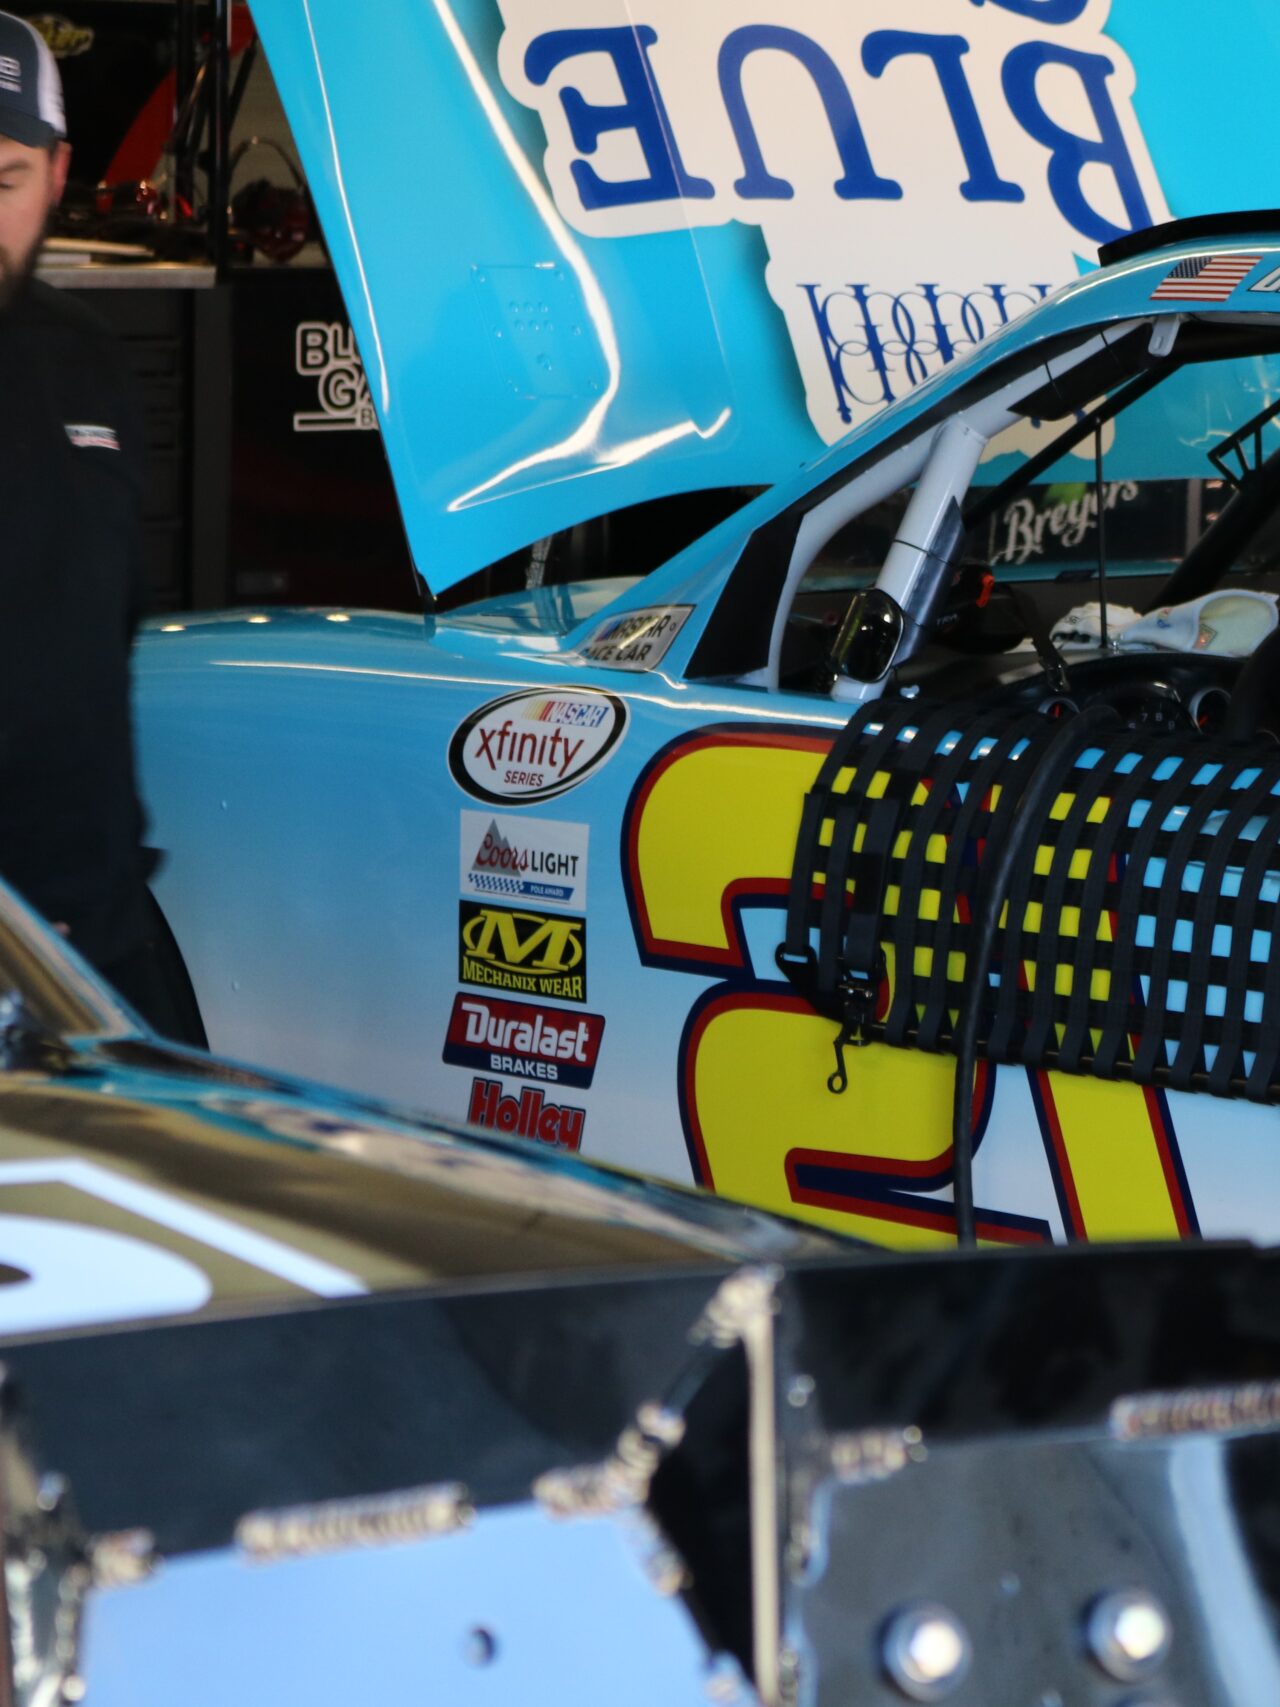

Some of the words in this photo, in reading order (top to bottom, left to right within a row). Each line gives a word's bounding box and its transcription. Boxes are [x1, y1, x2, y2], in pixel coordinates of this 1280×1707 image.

[523, 24, 1154, 246] BLUE
[615, 643, 652, 661] CAR
[548, 701, 608, 728] NASCAR
[474, 720, 585, 779] xfinity
[504, 770, 545, 787] SERIES
[476, 833, 529, 872] Coors
[531, 849, 580, 878] LIGHT
[462, 955, 538, 992] MECHANIX
[540, 975, 584, 999] WEAR
[461, 1001, 590, 1063] Duralast
[490, 1053, 559, 1081] BRAKES
[467, 1076, 587, 1153] Holley
